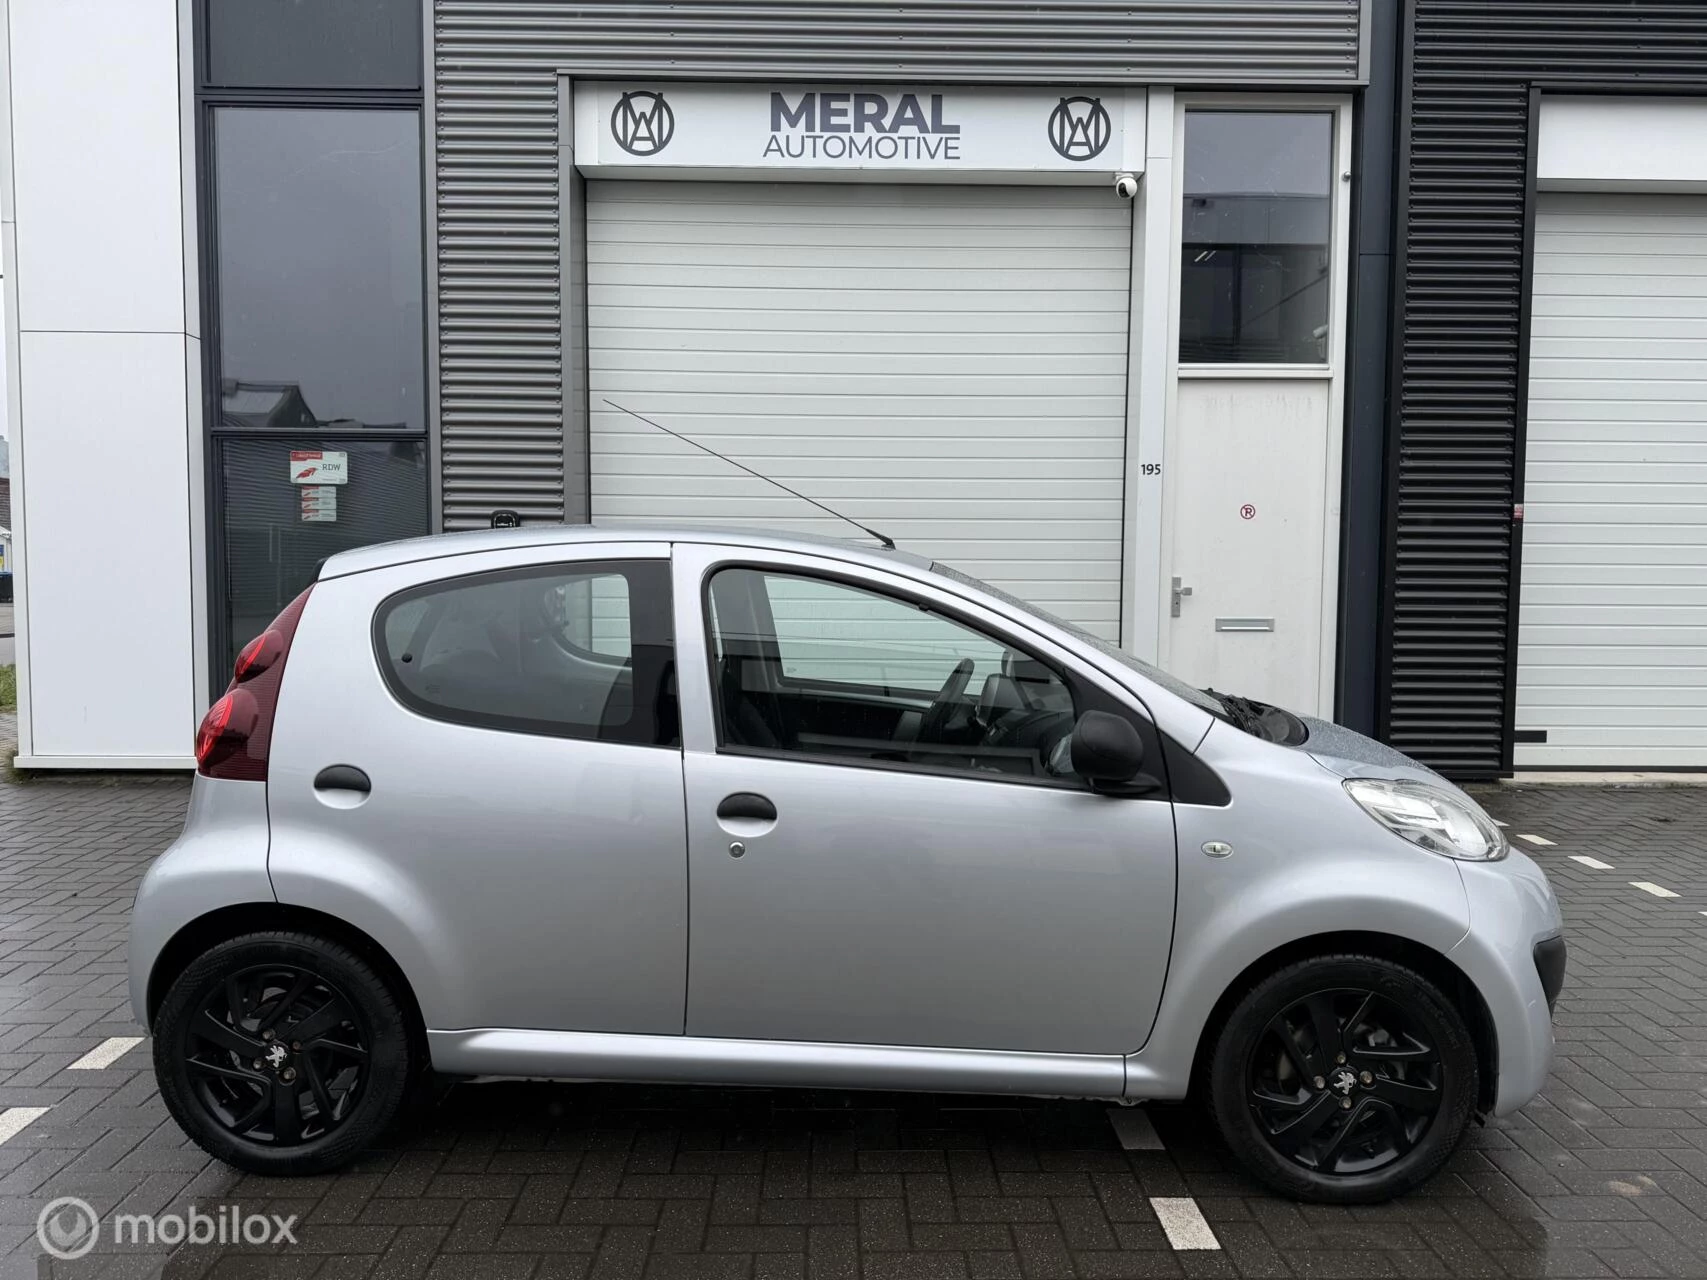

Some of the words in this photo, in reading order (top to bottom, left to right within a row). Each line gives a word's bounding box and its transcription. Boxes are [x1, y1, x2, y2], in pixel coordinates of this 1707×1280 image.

[770, 92, 961, 134] MERAL
[763, 134, 961, 160] AUTOMOTIVE
[322, 463, 341, 471] RDW
[1141, 463, 1162, 475] 195
